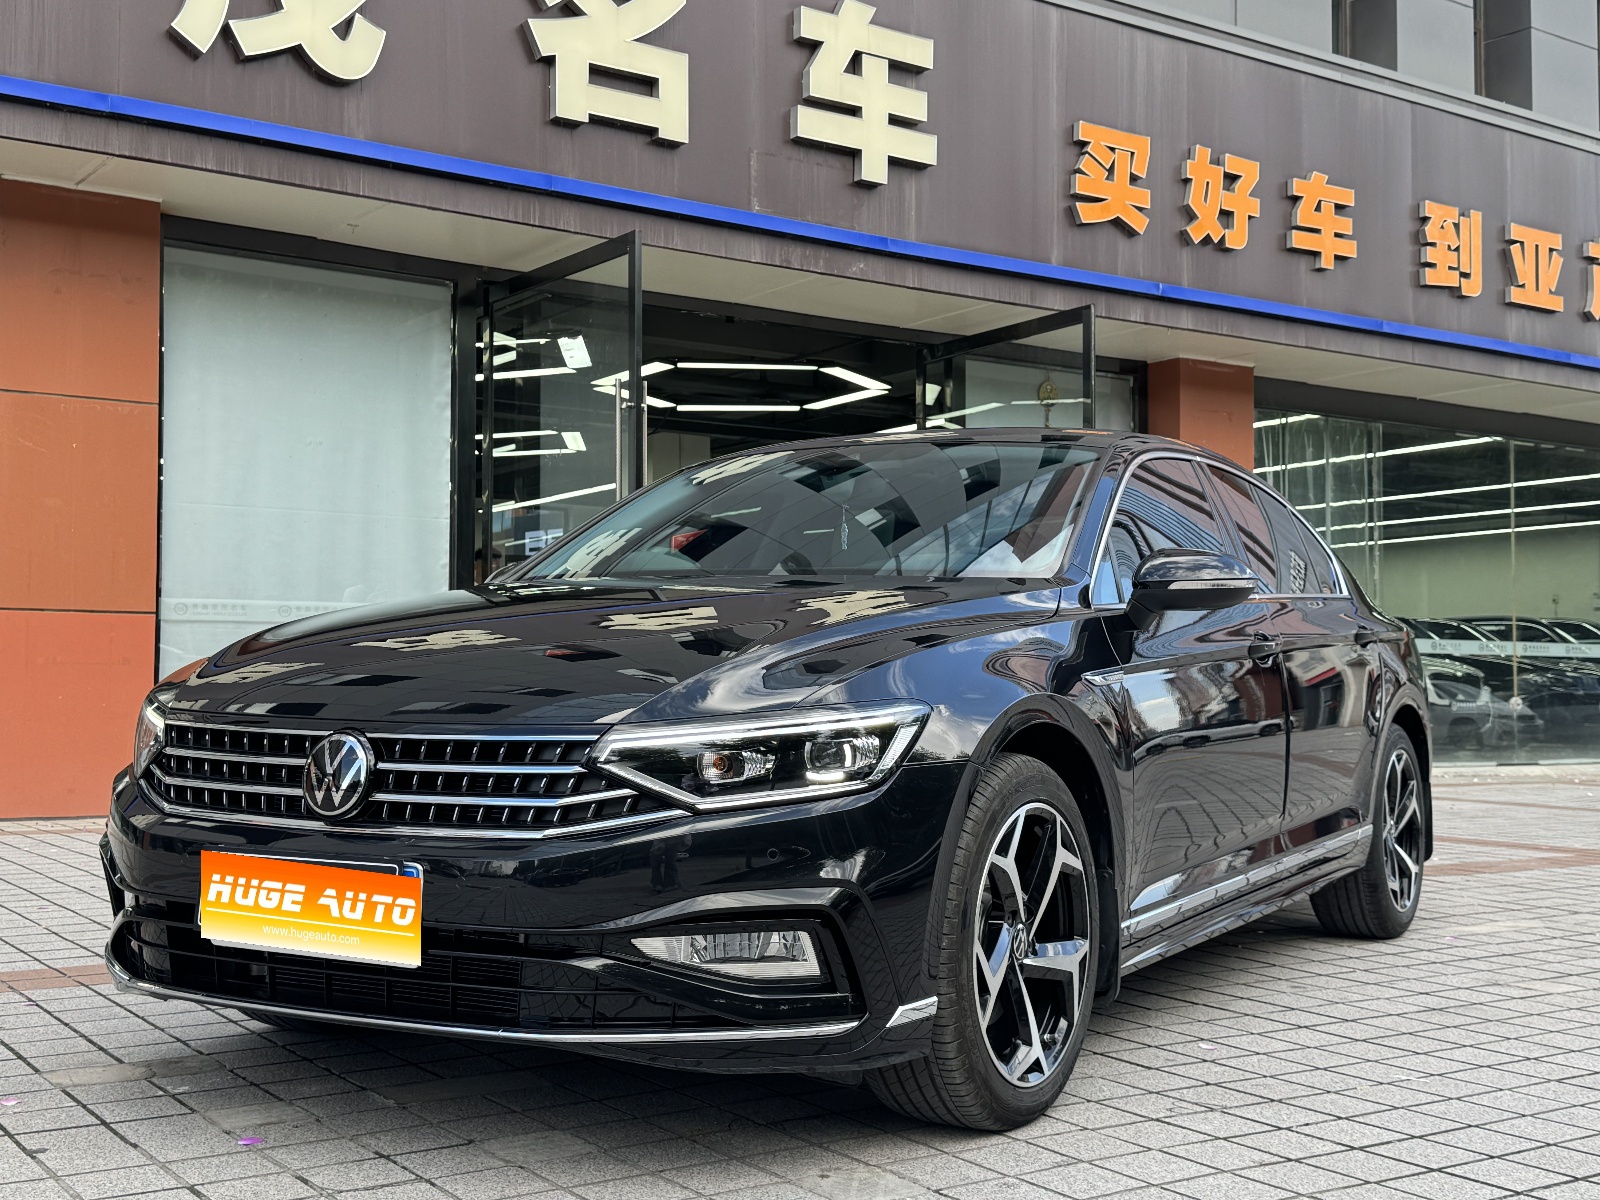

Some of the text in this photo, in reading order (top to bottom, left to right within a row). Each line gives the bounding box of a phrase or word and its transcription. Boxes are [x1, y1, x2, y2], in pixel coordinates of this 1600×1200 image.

[1070, 119, 1600, 322] 买好车 到亚
